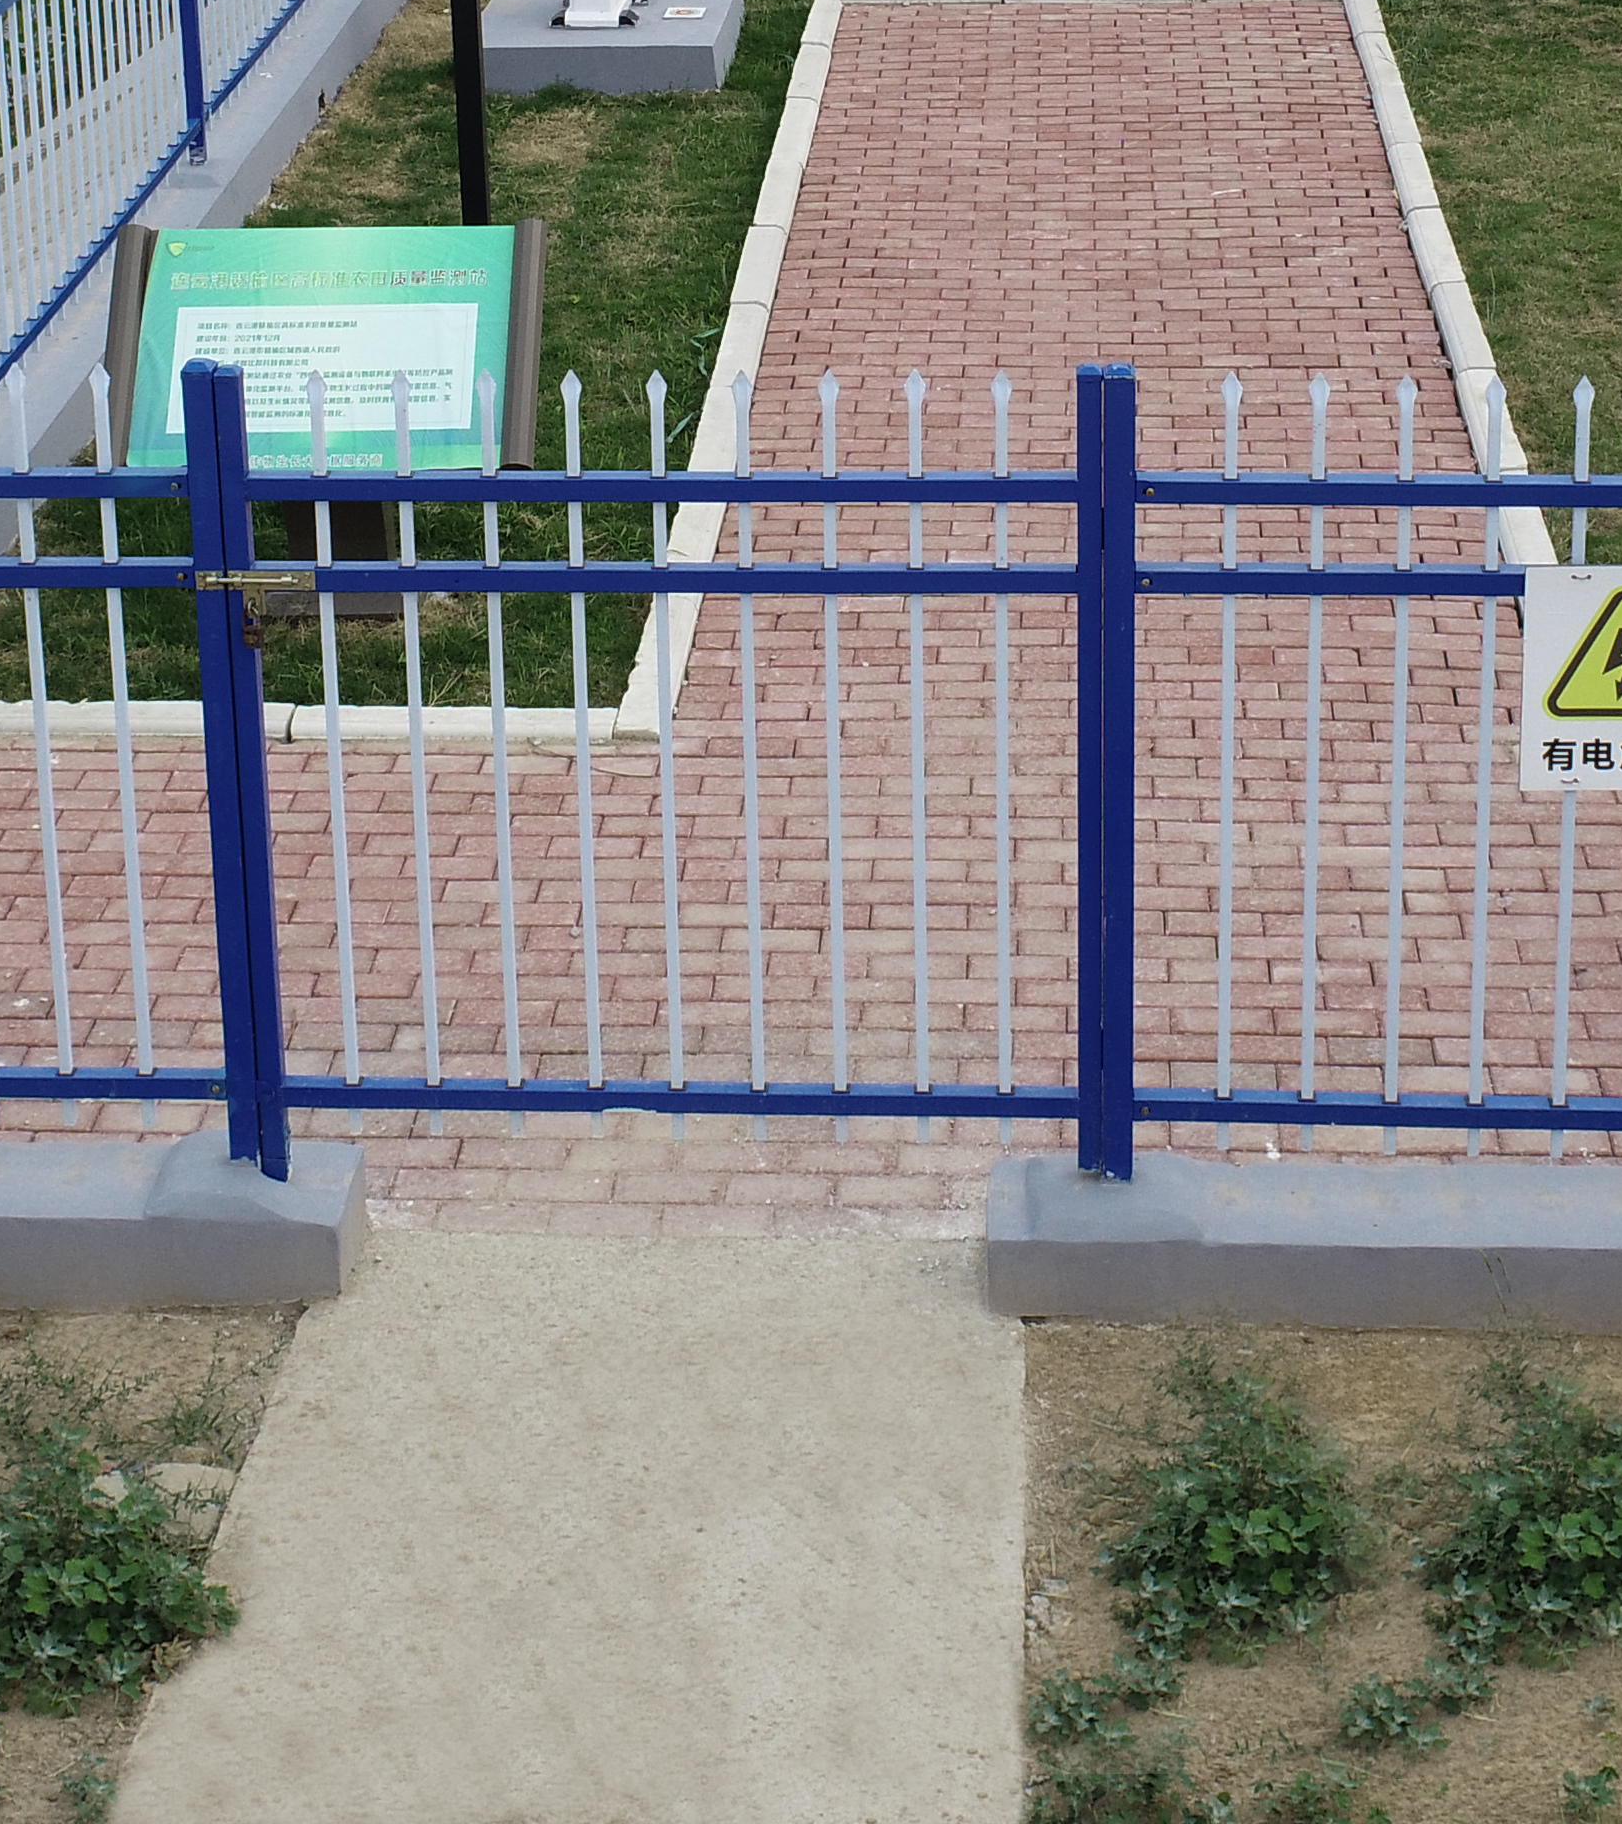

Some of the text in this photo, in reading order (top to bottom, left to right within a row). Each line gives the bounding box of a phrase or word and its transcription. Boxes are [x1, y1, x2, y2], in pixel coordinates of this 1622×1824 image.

[170, 268, 489, 291] 连云港赣榆区高标准农田质量监测站
[249, 454, 384, 469] 作物生长大据服务商
